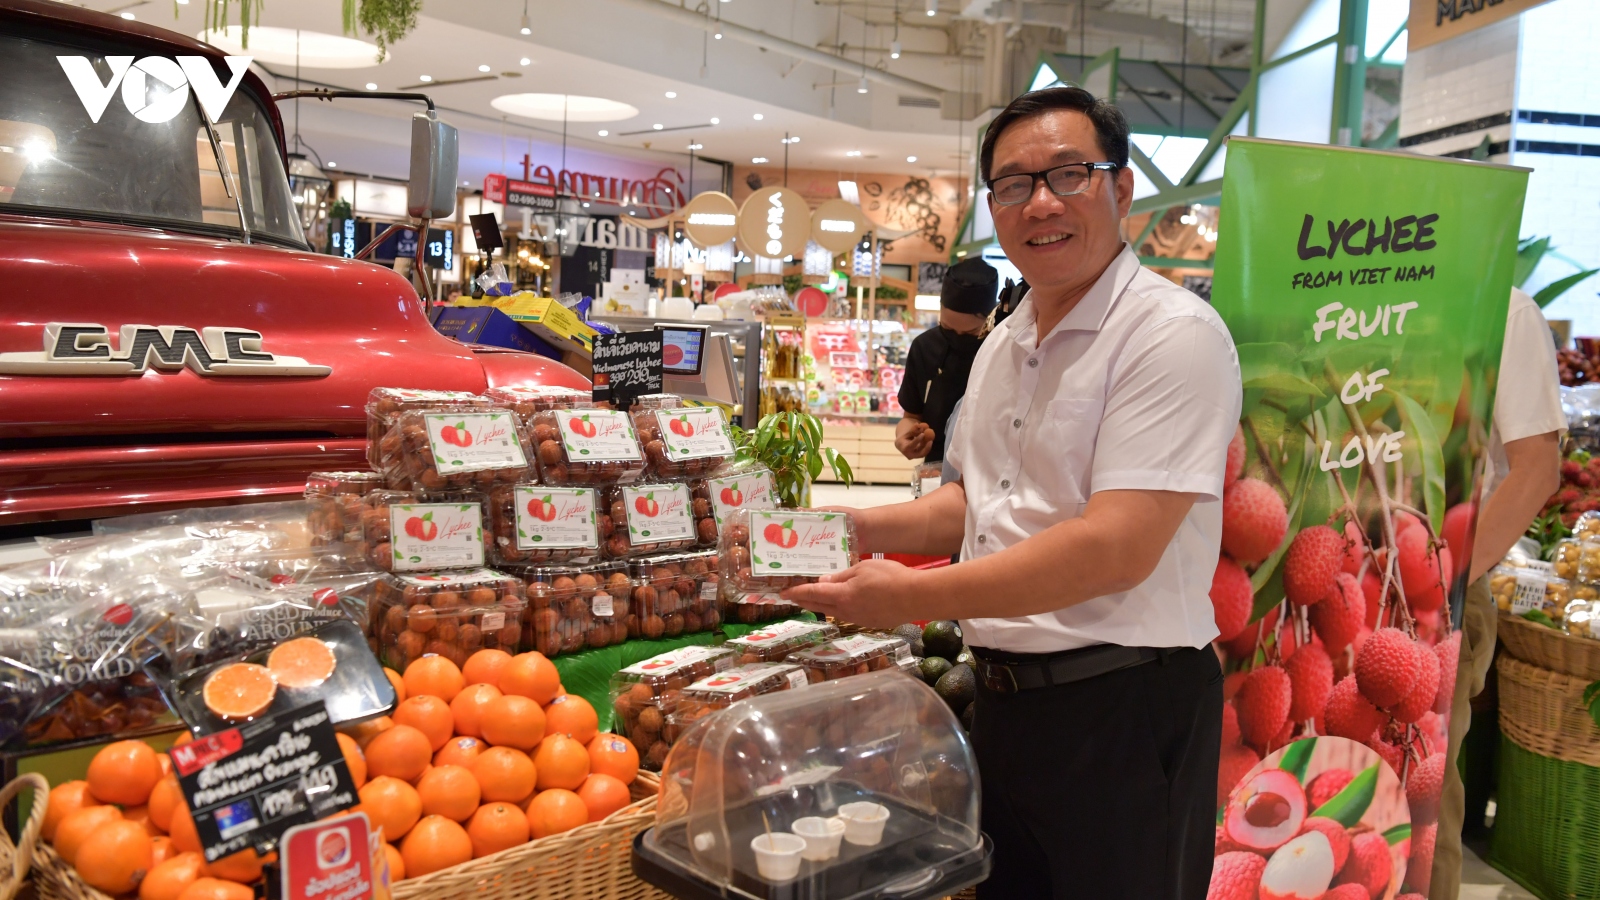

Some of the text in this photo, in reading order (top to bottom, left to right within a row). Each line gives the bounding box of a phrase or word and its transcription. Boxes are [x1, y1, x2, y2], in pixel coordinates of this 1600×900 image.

[509, 193, 554, 208] 02-690-1000
[343, 218, 355, 259] ASHIER
[1297, 213, 1440, 261] LYCHEE
[429, 241, 443, 257] 13
[444, 230, 453, 270] CASHIER
[588, 261, 599, 272] 14
[1292, 265, 1435, 290] FROM VIET NAM
[1313, 301, 1419, 342] FRUIT
[46, 322, 275, 375] GMC
[1340, 368, 1390, 405] OF
[475, 424, 506, 446] Lychee
[599, 418, 623, 437] Lychee
[696, 417, 718, 435] Lychee
[1319, 431, 1405, 472] LOVE
[745, 482, 766, 503] Lychee
[558, 500, 587, 521] Lychee
[661, 495, 683, 515] Lychee
[440, 516, 472, 540] Lychee
[800, 525, 836, 548] Lychee
[766, 552, 778, 560] 1kg
[302, 606, 343, 621] produce
[38, 658, 135, 690] WORLD
